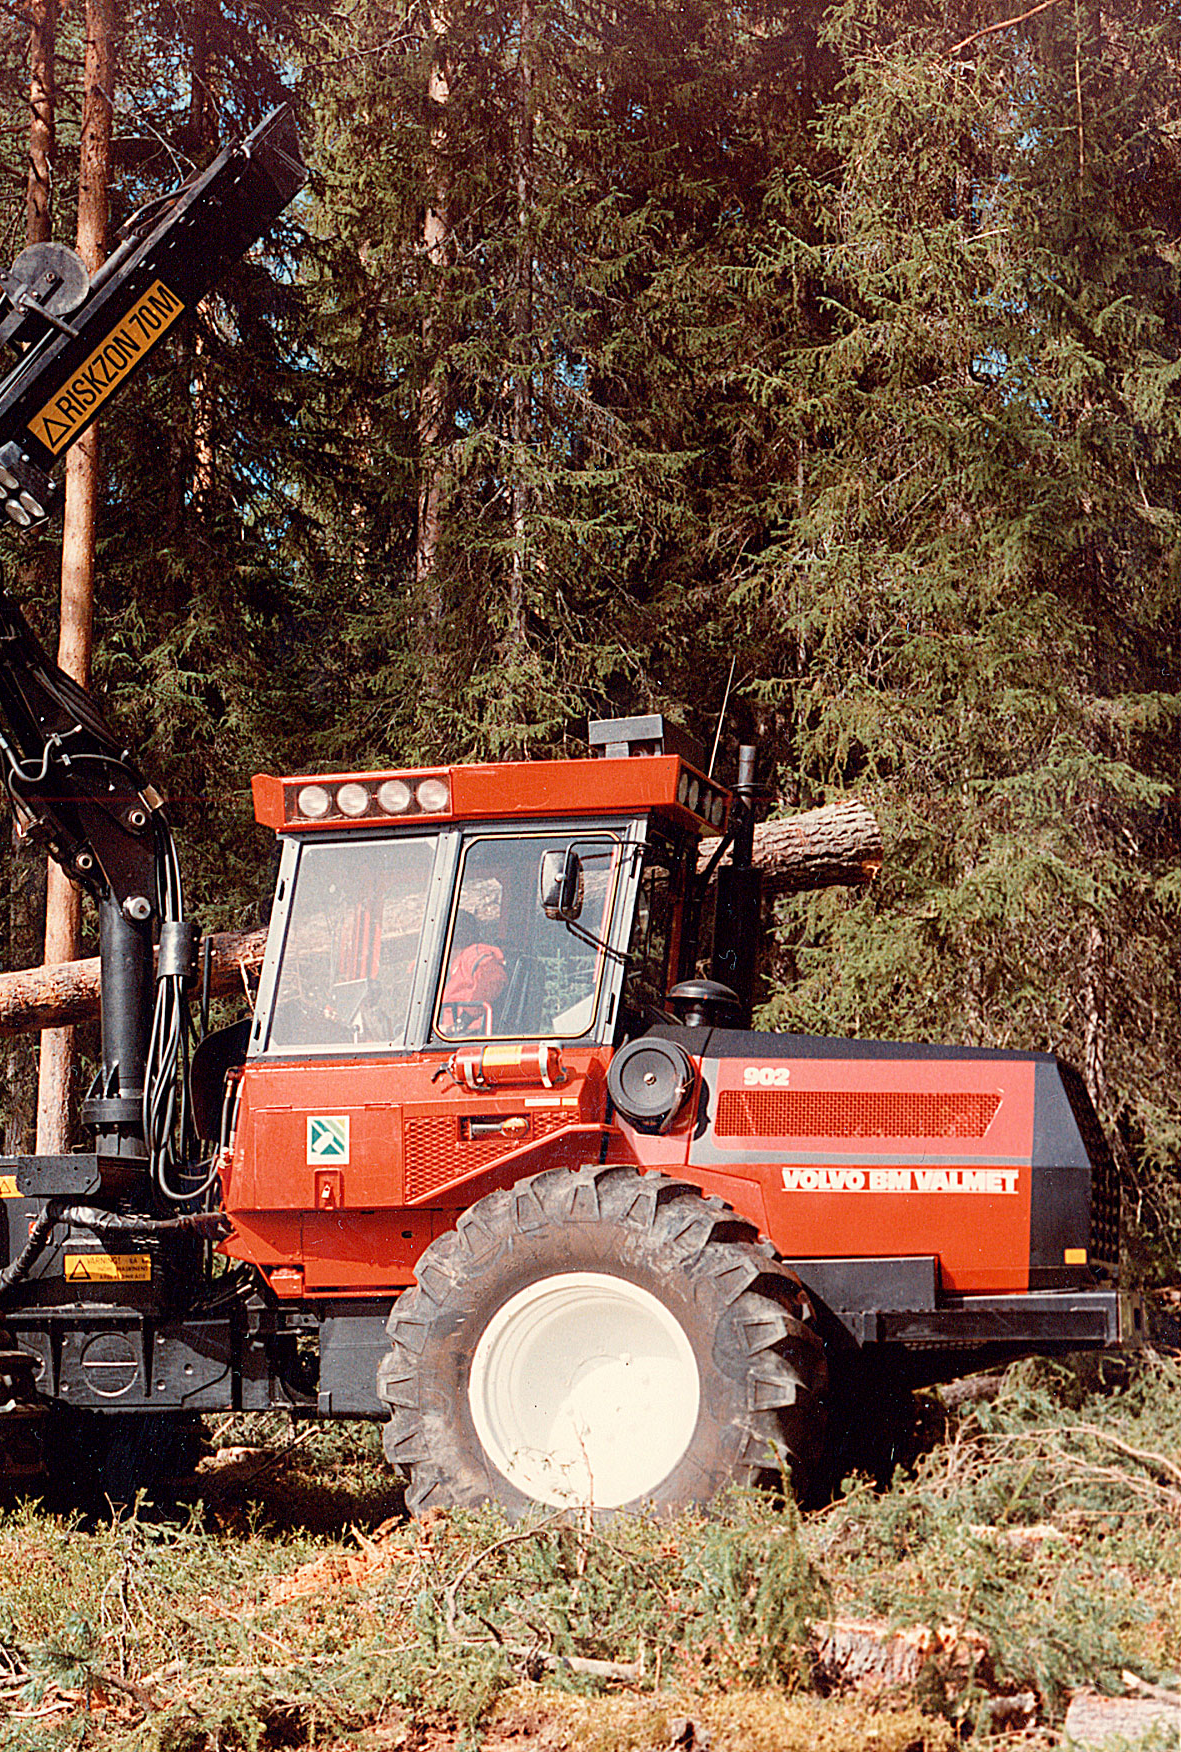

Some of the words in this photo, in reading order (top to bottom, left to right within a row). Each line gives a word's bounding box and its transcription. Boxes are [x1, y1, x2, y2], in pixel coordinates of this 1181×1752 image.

[55, 329, 141, 424] RISKZON
[129, 285, 180, 340] 70M
[743, 1067, 790, 1086] 902
[782, 1169, 865, 1190] VOLVO
[869, 1170, 912, 1191] BM
[914, 1170, 1019, 1192] VALMET
